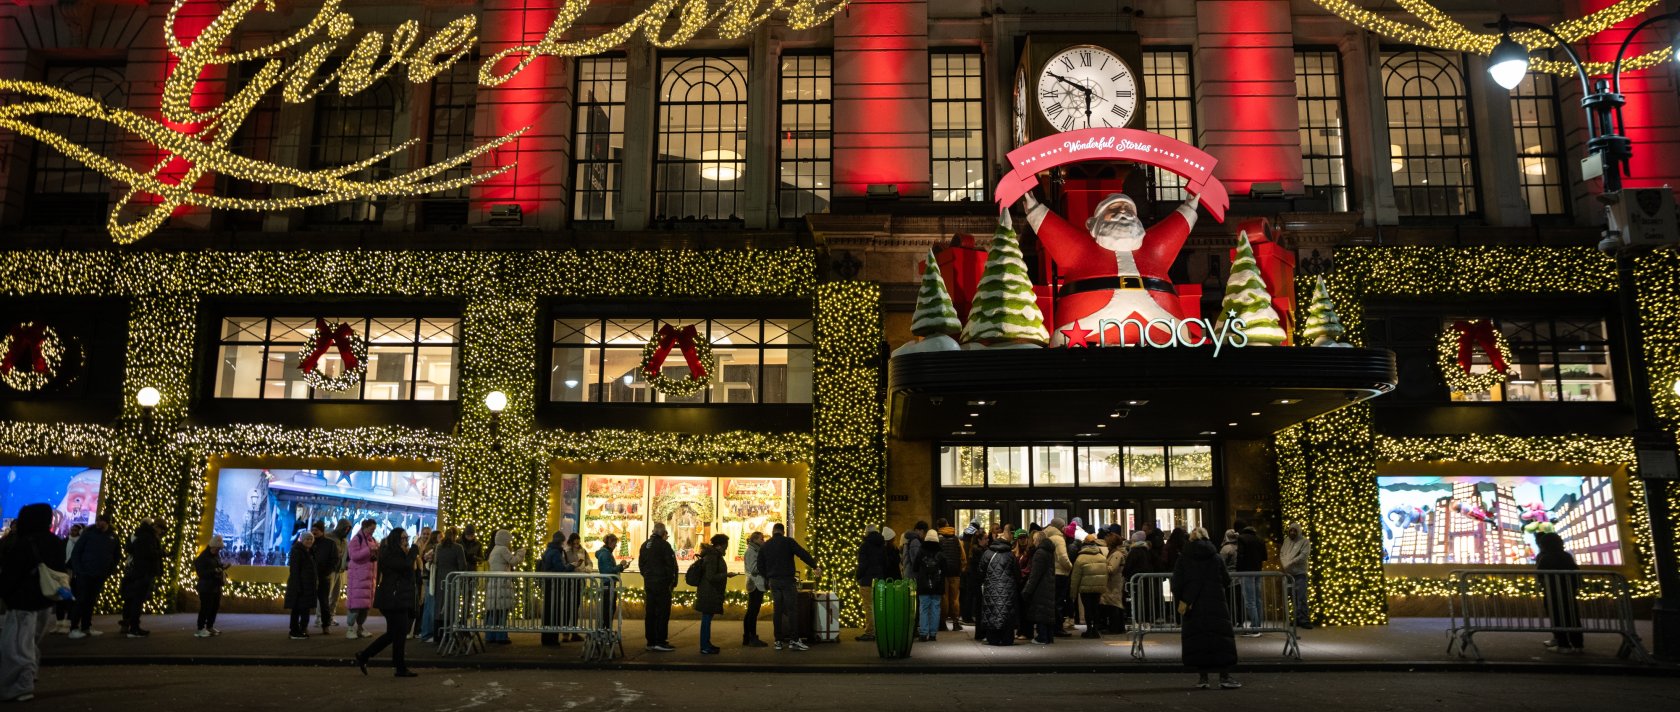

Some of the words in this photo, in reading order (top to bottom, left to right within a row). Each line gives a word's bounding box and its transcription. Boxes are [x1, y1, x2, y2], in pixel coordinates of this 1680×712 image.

[107, 0, 478, 244] Give
[1020, 156, 1036, 166] THE
[1040, 147, 1063, 158] MOST
[1063, 136, 1115, 153] Wonderful
[1116, 138, 1152, 153] Stories
[1153, 147, 1180, 160] START
[1183, 158, 1205, 172] HERE
